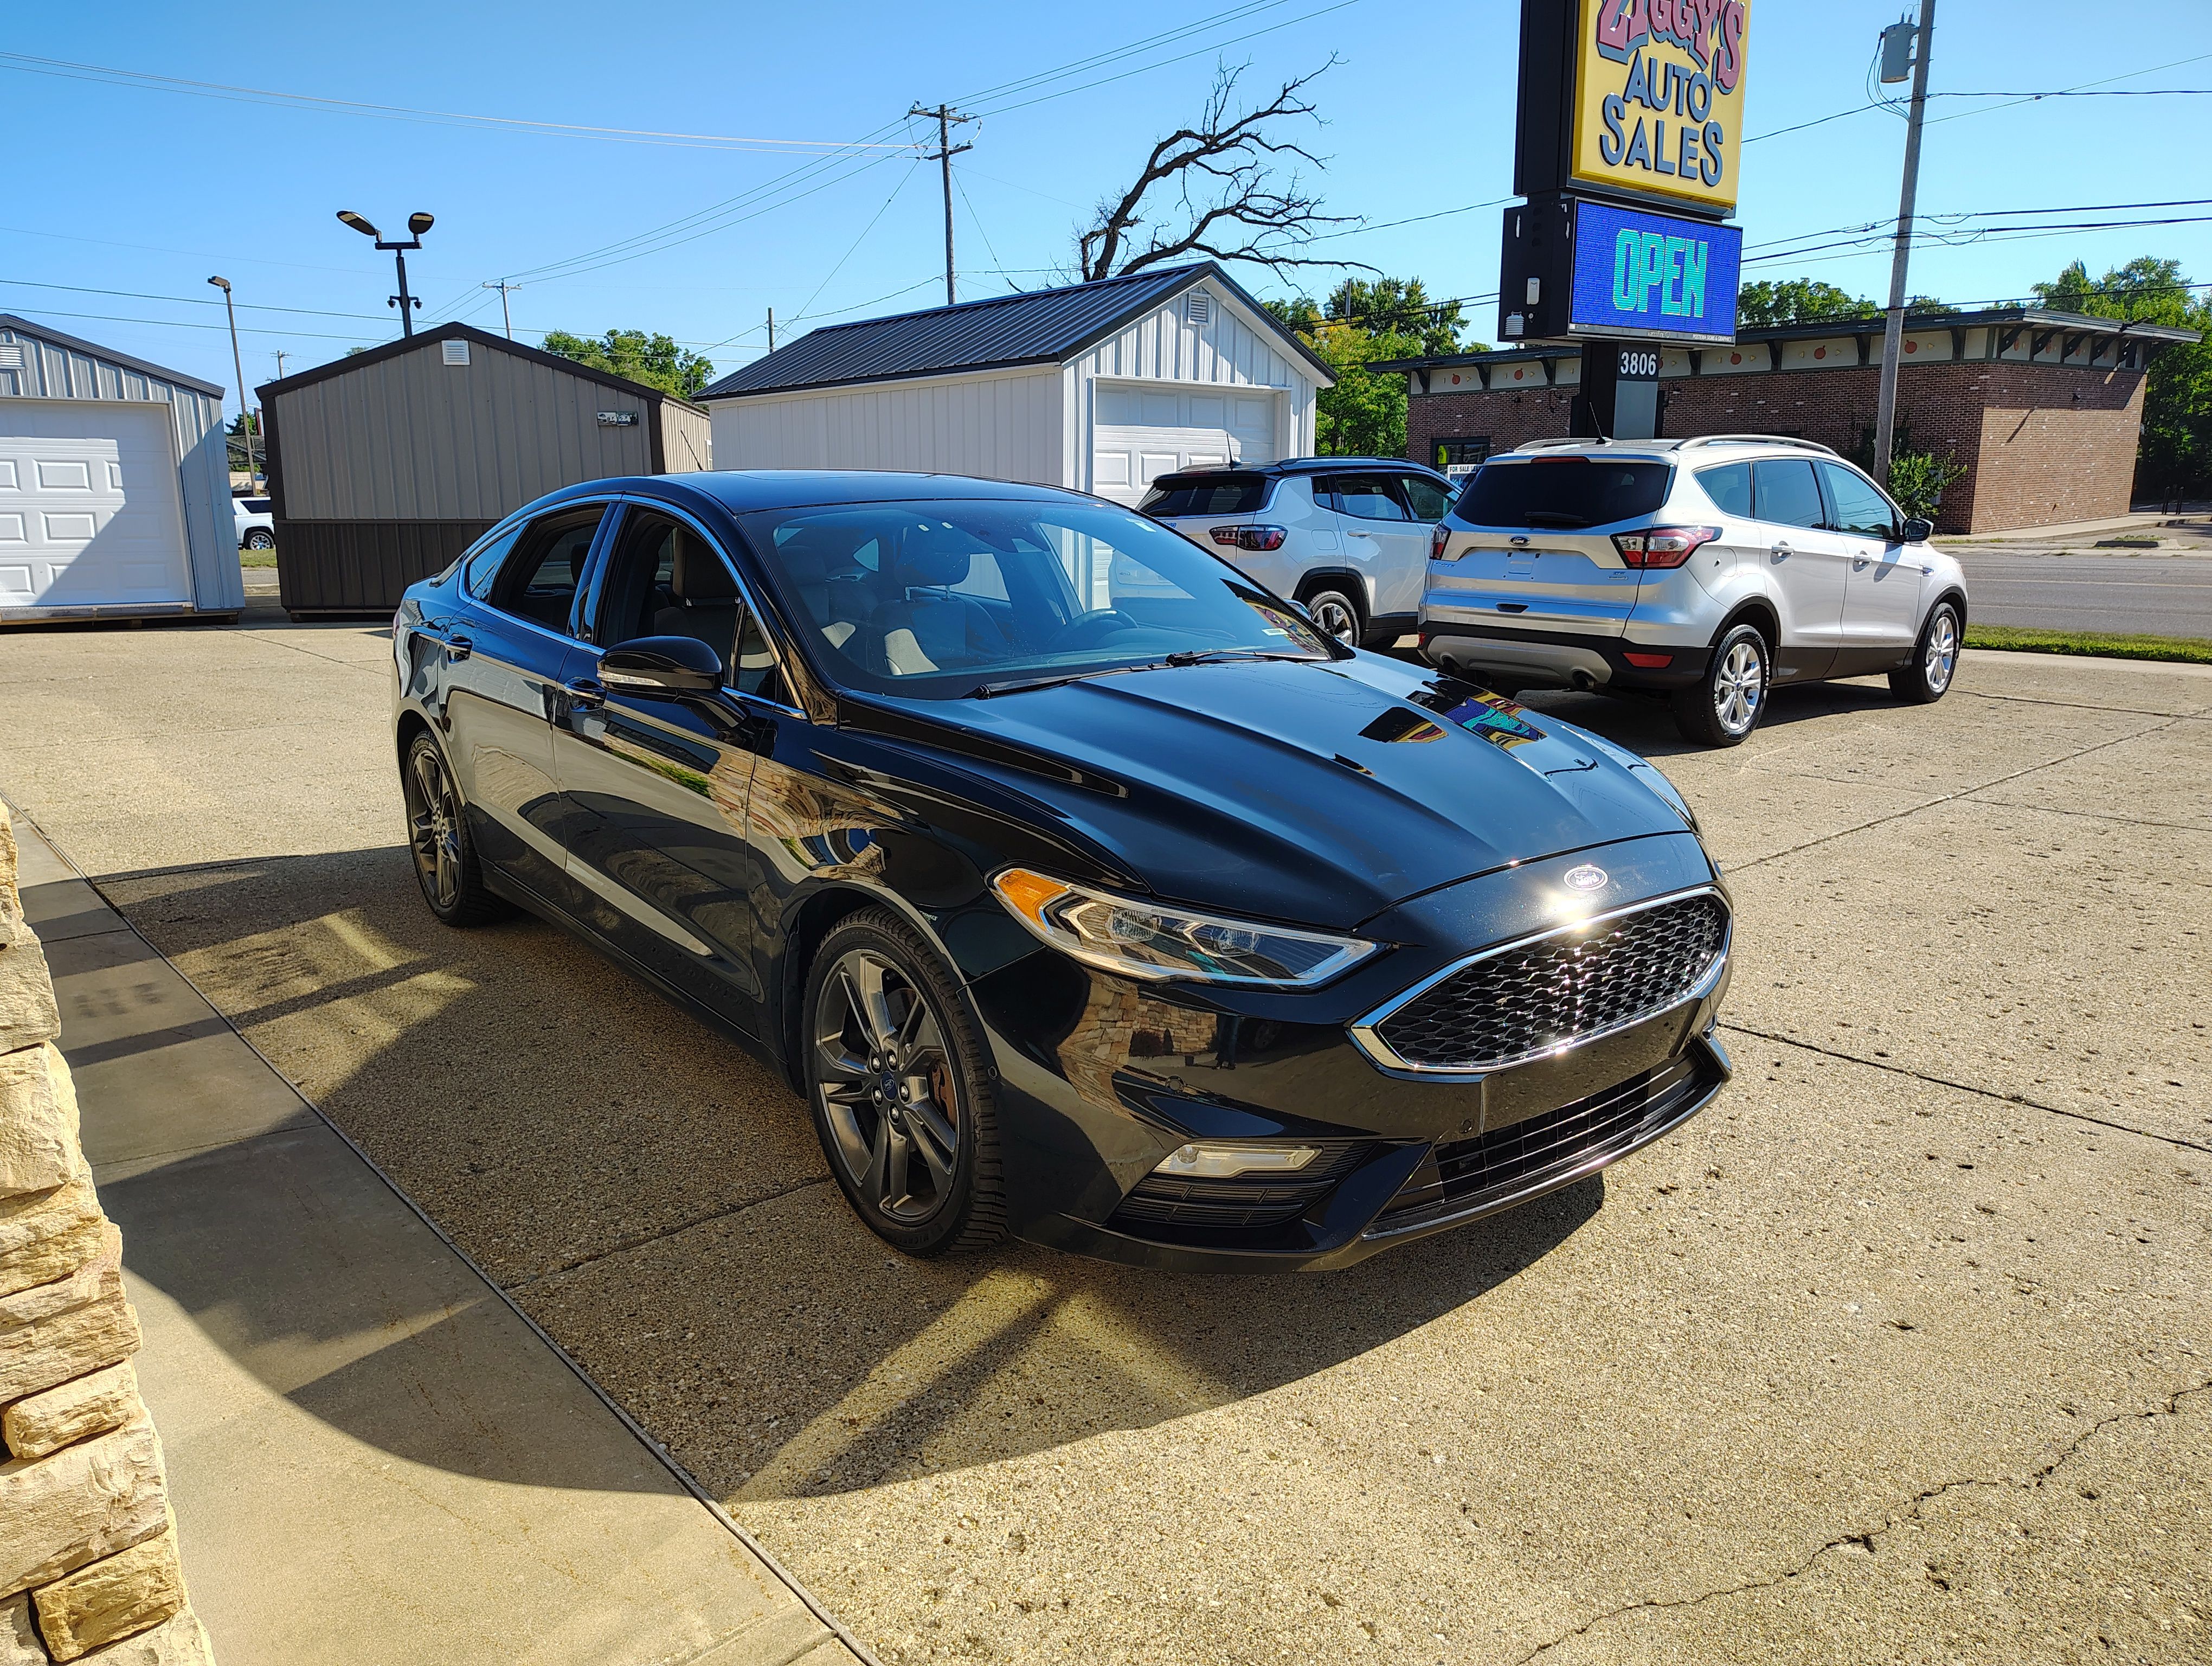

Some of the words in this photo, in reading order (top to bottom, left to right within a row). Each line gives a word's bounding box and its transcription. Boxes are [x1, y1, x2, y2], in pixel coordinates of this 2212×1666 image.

[1623, 48, 1712, 123] AUTO
[1599, 91, 1724, 188] SALES
[1613, 228, 1708, 318] OPEN
[1620, 351, 1657, 376] 3806
